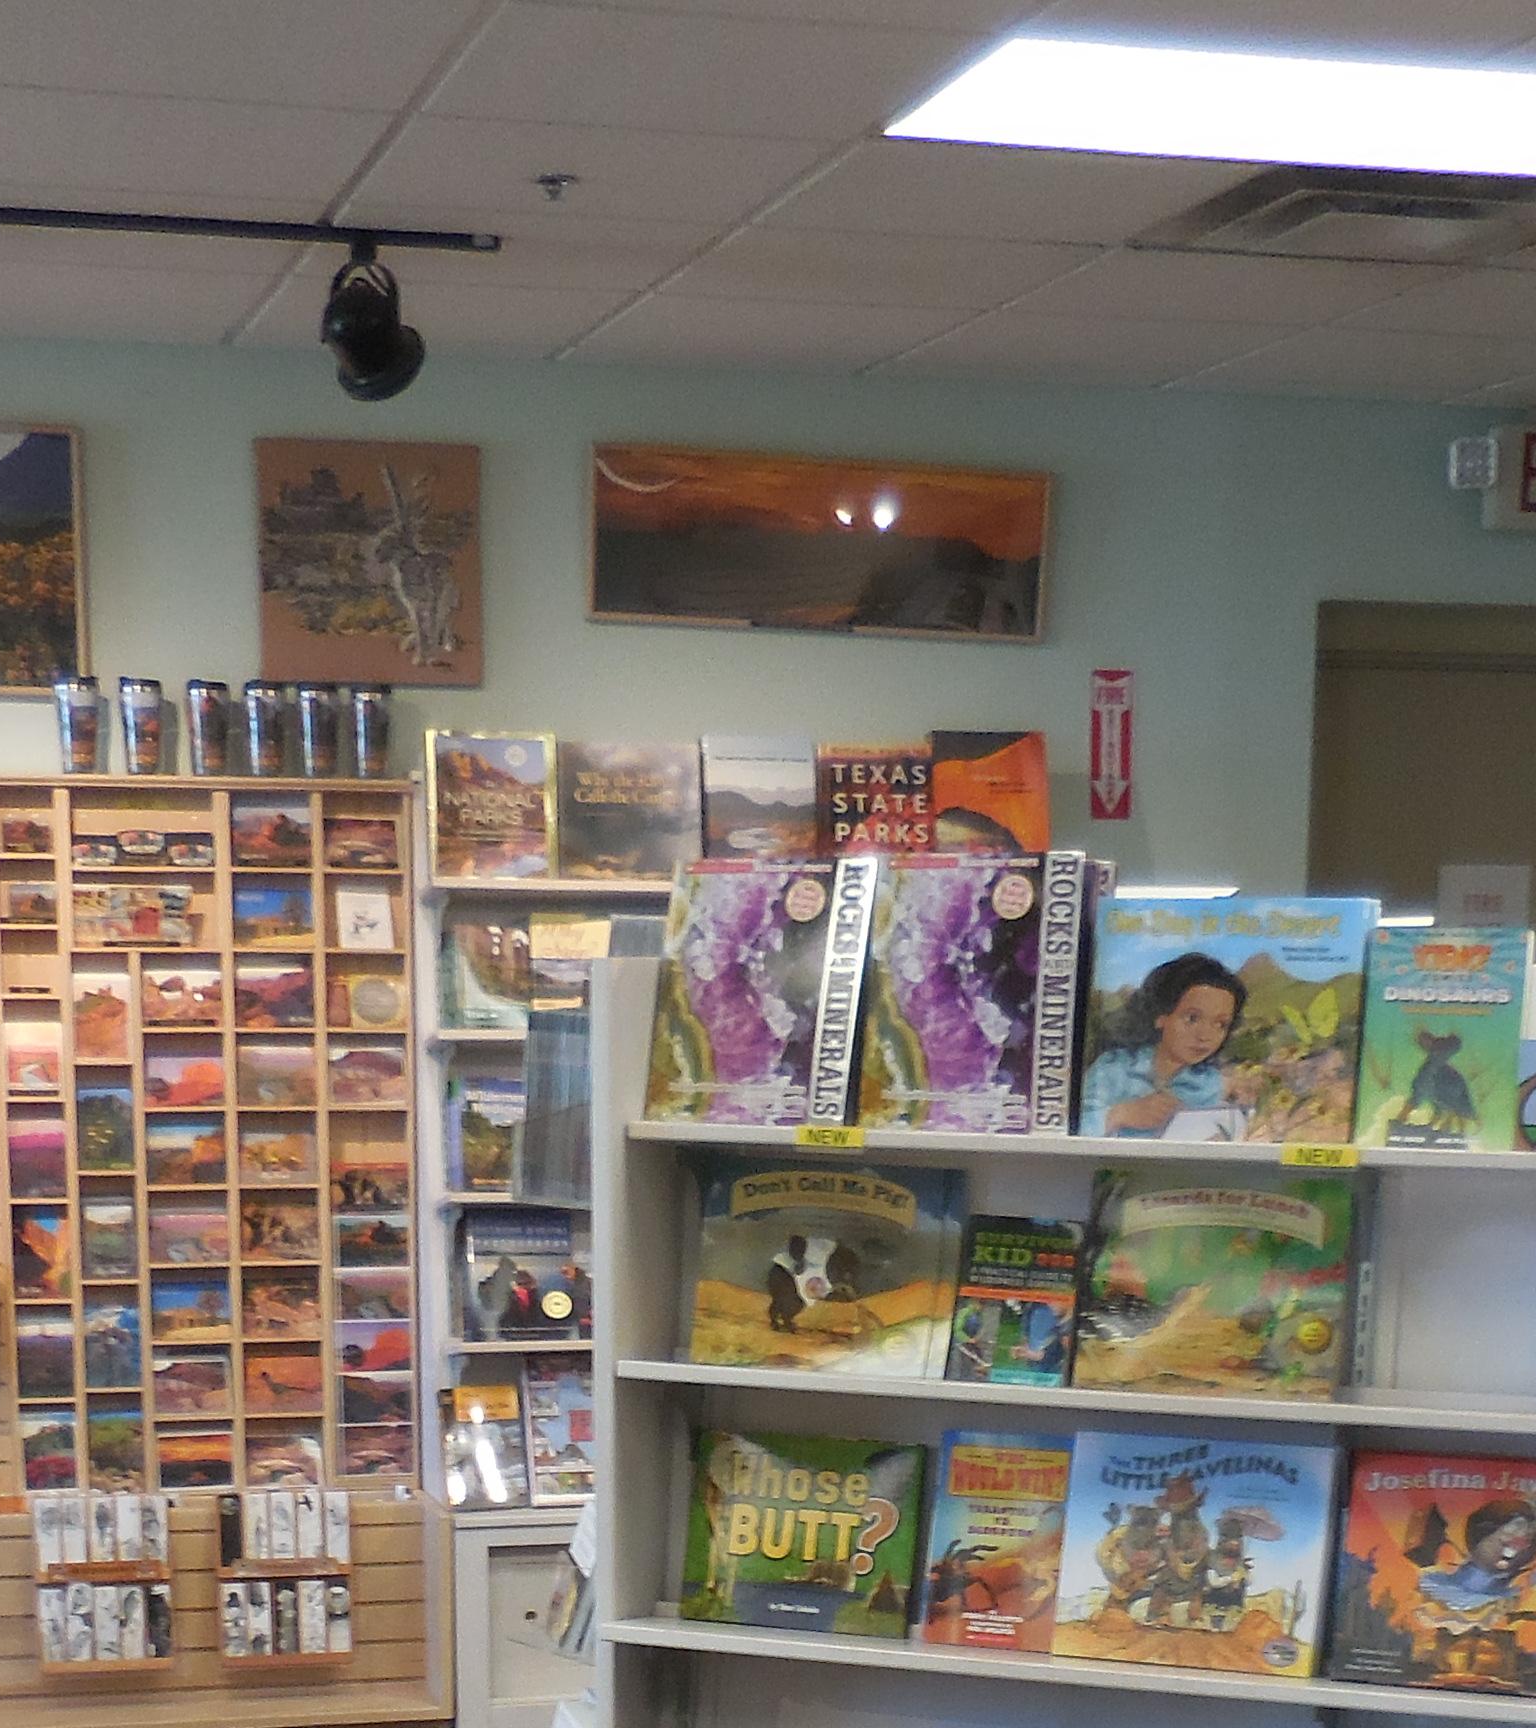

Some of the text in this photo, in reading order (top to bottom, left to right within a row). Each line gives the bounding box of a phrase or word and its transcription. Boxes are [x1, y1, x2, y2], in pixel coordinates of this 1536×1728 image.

[831, 764, 927, 785] TEXAS
[443, 791, 538, 808] NATIONAL
[832, 792, 929, 814] STATE
[461, 808, 522, 826] PARKS
[834, 823, 930, 843] PARKS
[832, 863, 870, 954] ROCKS
[1044, 860, 1078, 956] ROCKS
[813, 970, 859, 1119] MINERALS
[1035, 974, 1077, 1130] MINERALS
[806, 1129, 849, 1146] NEW
[1295, 1148, 1343, 1165] NEW
[798, 1177, 835, 1192] Call
[1132, 1443, 1211, 1471] THREE
[729, 1450, 871, 1507] Whose
[1101, 1465, 1171, 1491] LITTLE
[1189, 1454, 1301, 1486] AVELINAS
[1364, 1466, 1487, 1494] Josefina
[727, 1496, 900, 1576] BUTT?
